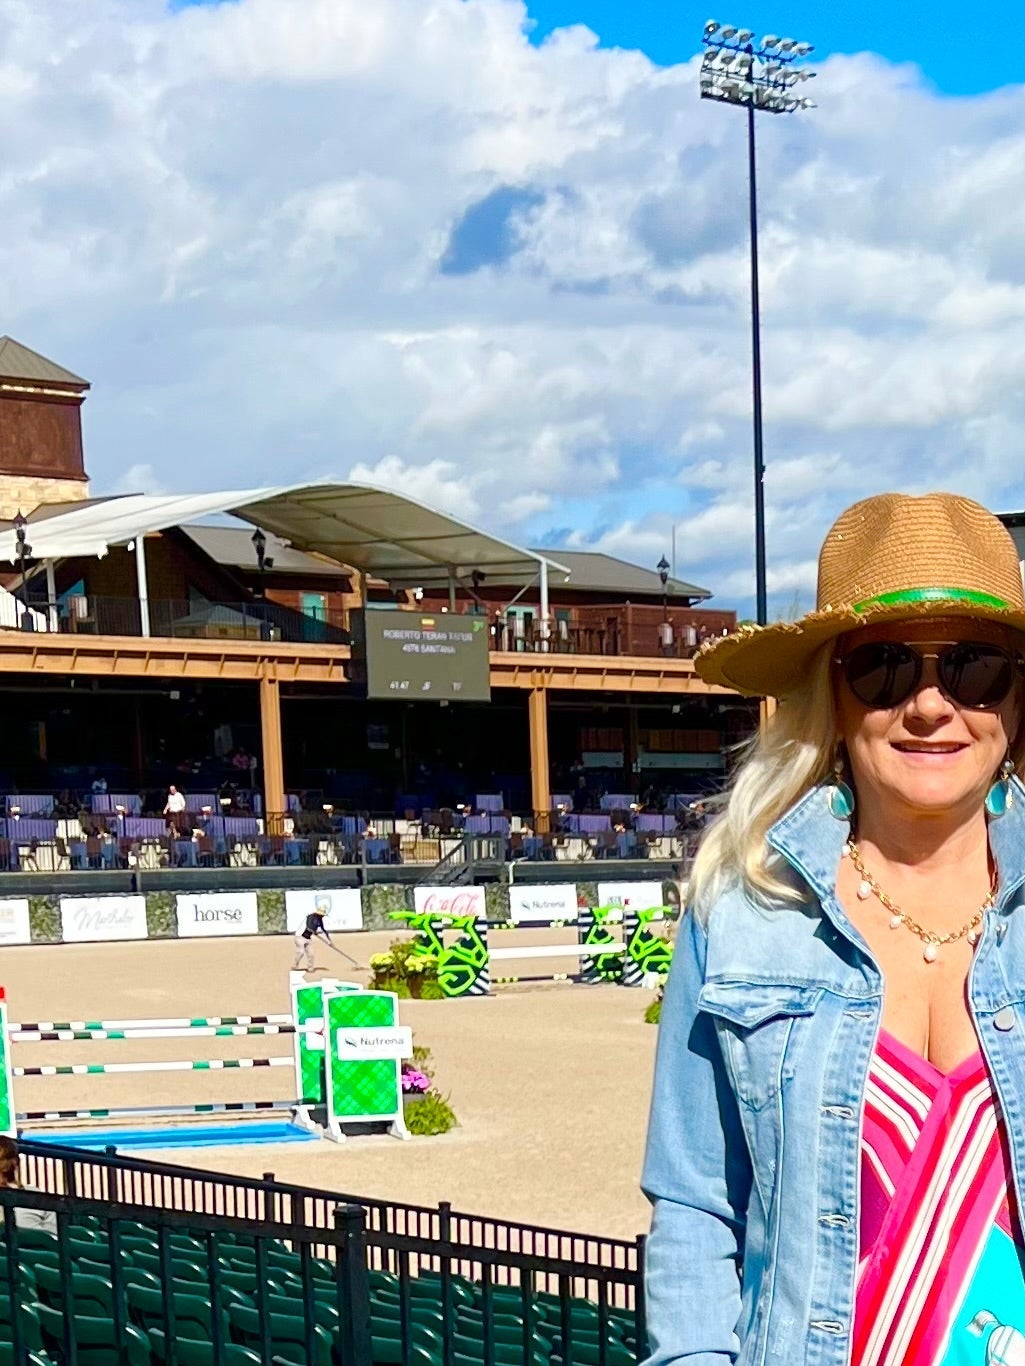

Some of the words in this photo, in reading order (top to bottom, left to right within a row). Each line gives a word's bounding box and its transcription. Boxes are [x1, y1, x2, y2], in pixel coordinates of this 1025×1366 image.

[532, 901, 566, 909] Nutrena
[192, 904, 243, 922] horse
[360, 1037, 405, 1046] Nutrena
